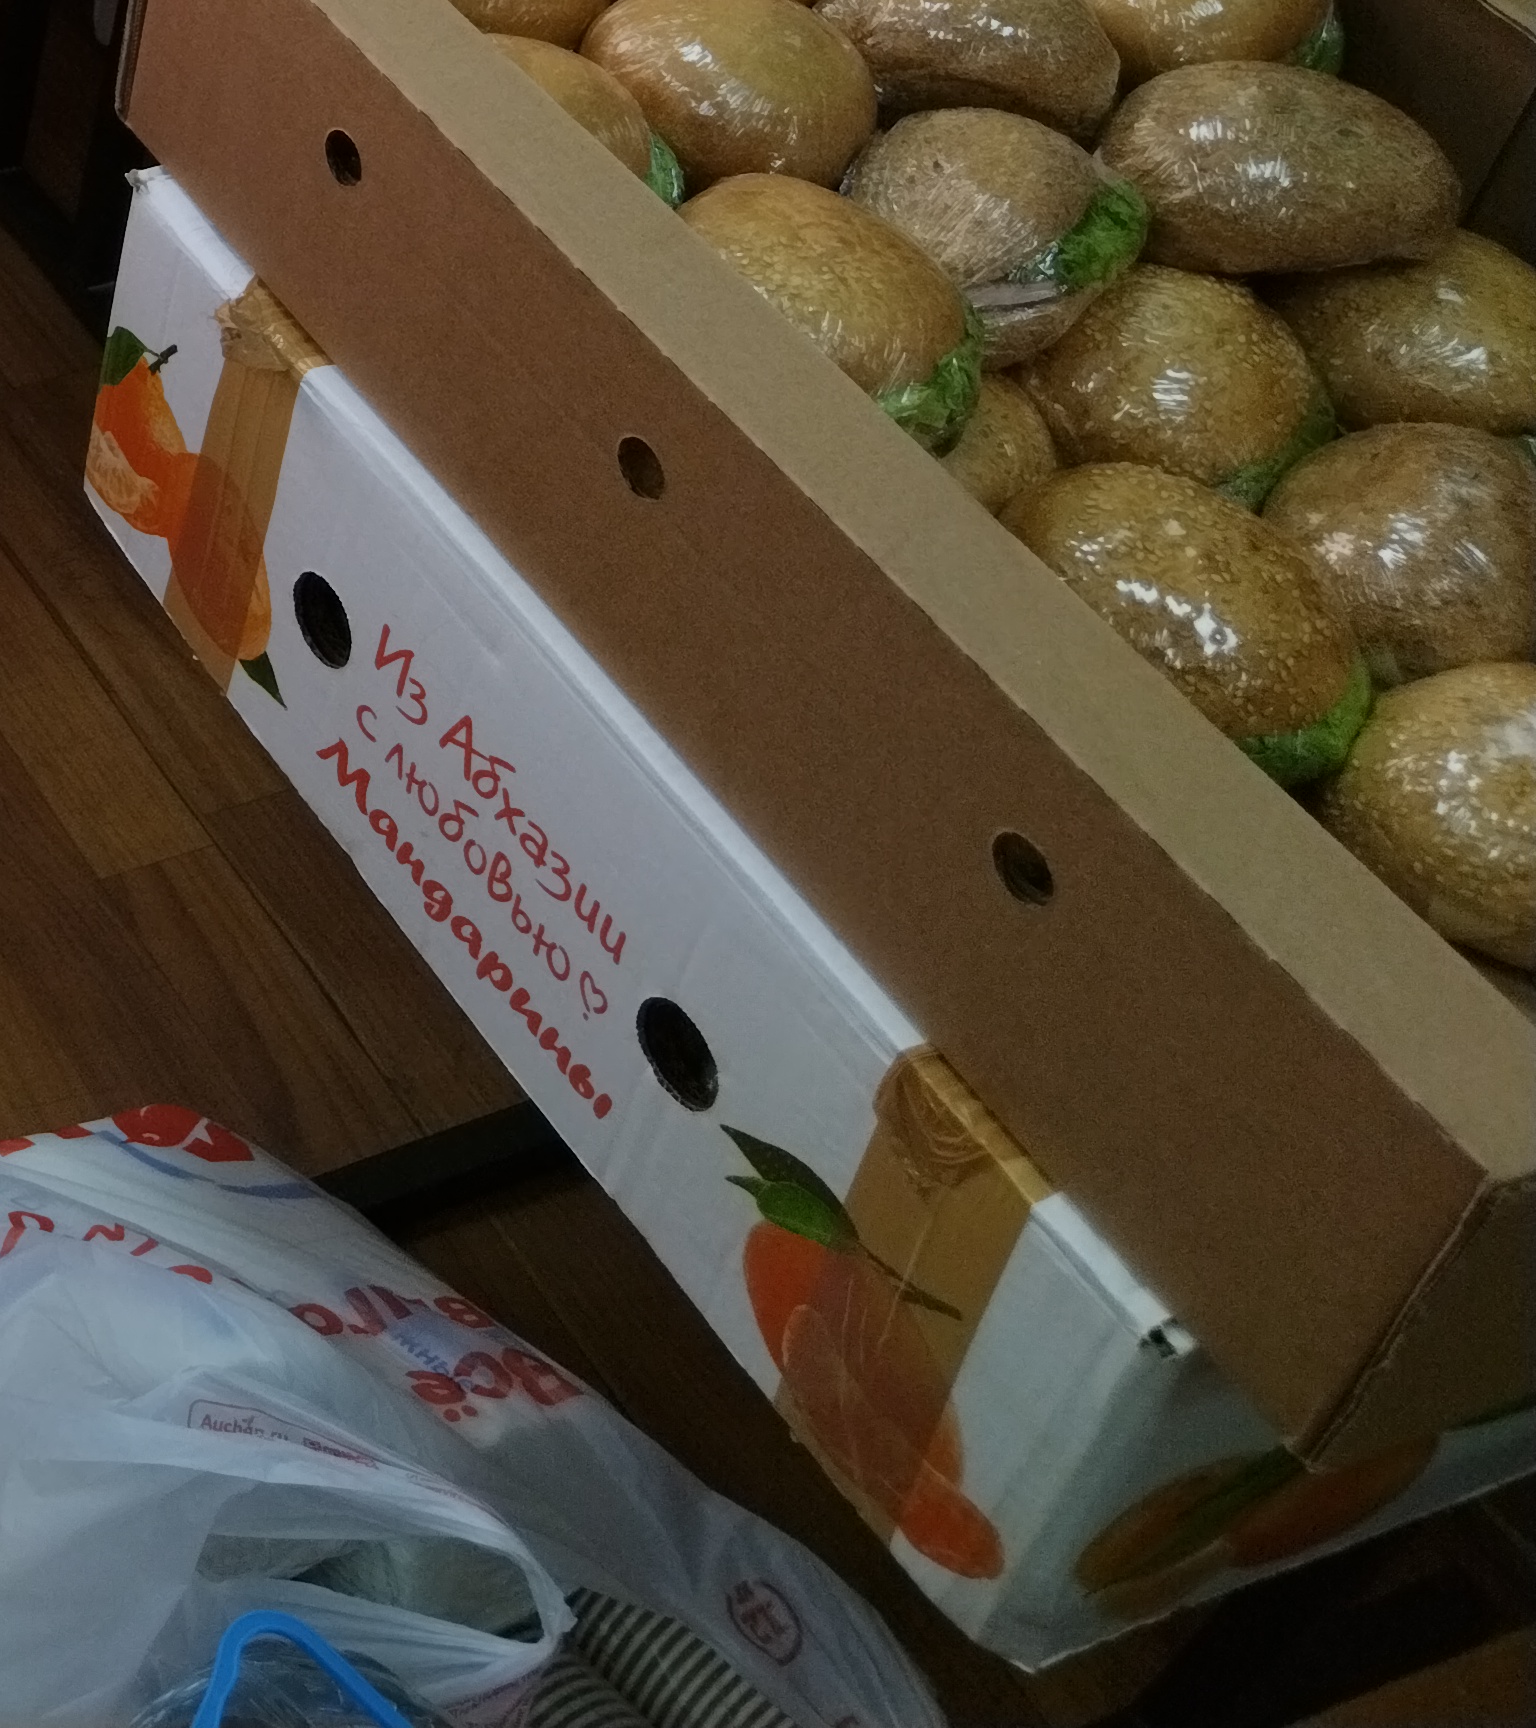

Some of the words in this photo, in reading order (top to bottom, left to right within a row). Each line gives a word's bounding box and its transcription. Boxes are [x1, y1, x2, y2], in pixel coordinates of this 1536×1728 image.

[316, 737, 614, 1120] Мандарины
[374, 623, 428, 726] Из
[439, 714, 627, 965] Абхазии
[385, 743, 571, 981] любовью
